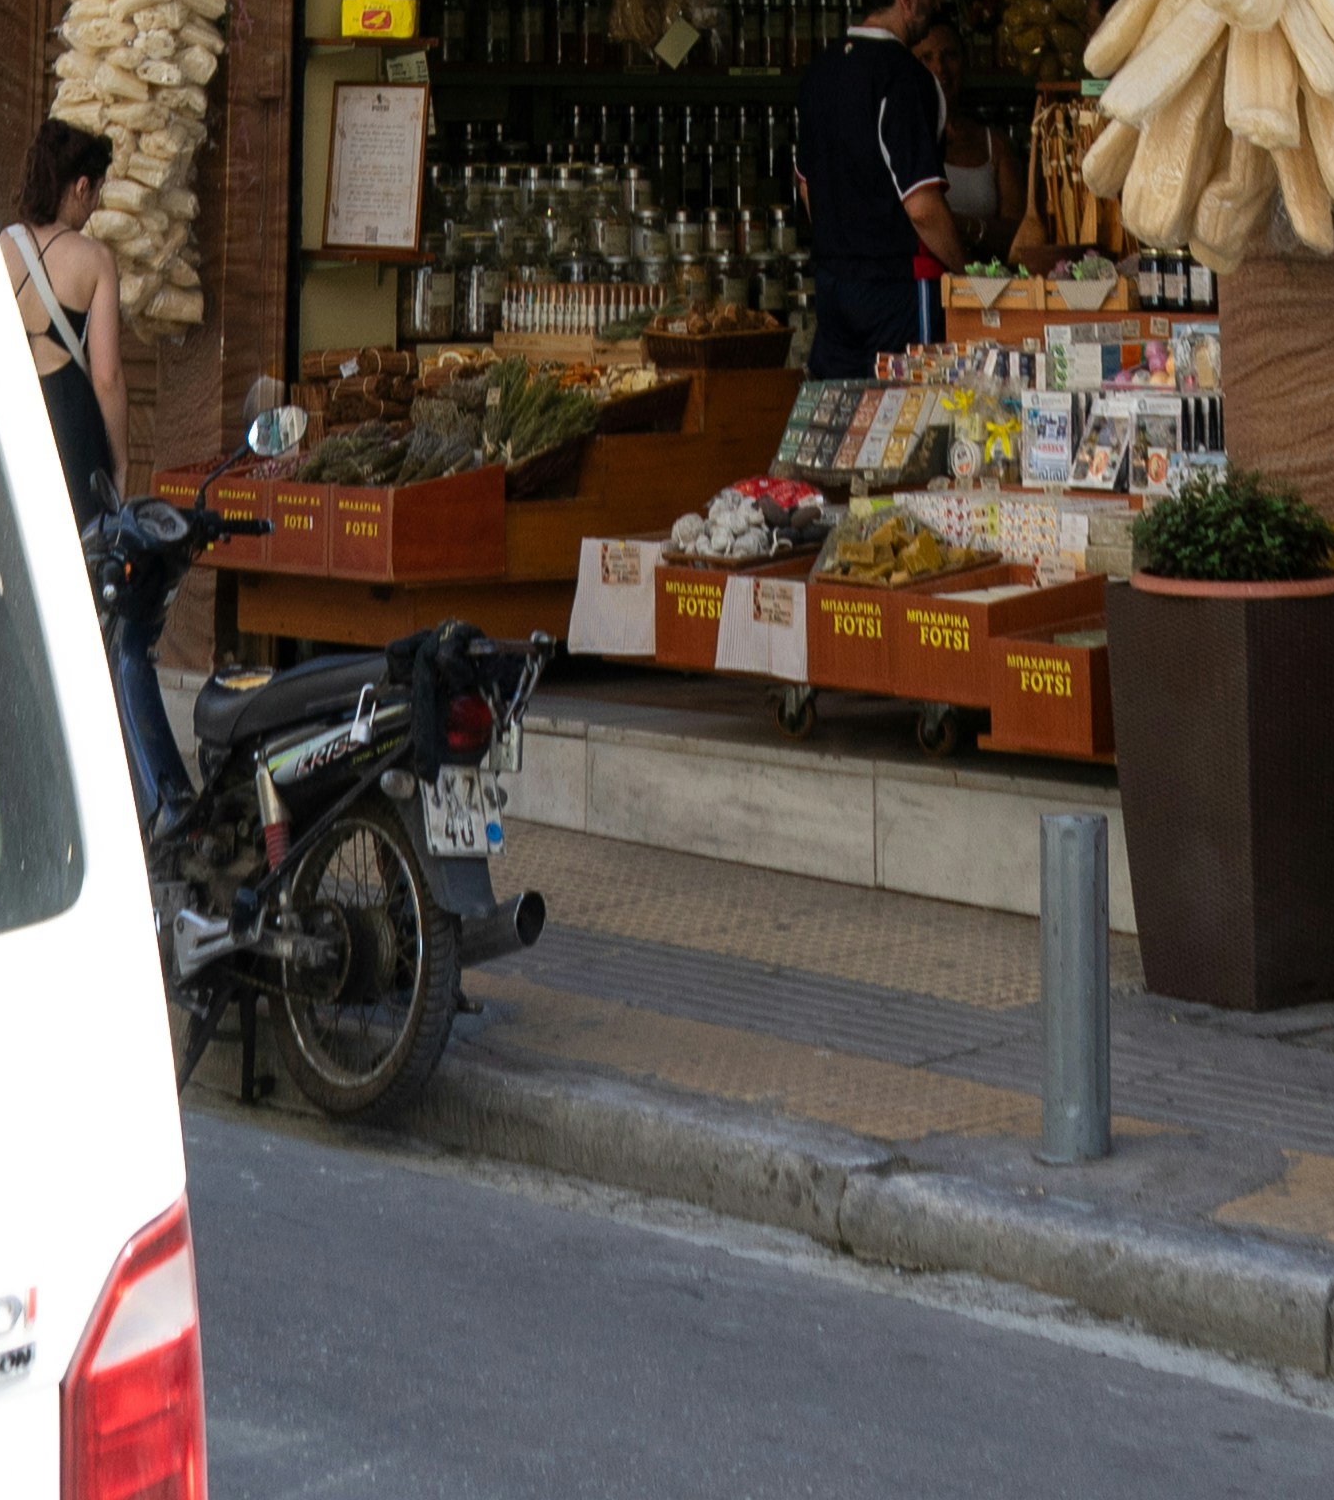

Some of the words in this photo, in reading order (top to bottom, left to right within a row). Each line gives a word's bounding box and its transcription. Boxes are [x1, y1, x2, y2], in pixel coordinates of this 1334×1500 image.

[284, 514, 313, 530] FOTSI
[346, 521, 378, 537] FOTSI
[666, 581, 722, 599] ΜΠΑΧΑΡΙΚΑ
[677, 597, 722, 619] FOTSI
[821, 599, 882, 617] ΜΠΑΧΑΡΙΚΑ
[833, 615, 883, 639] FOTSI
[907, 609, 969, 629] ΜΠΑΧΑΡΙΚΑ
[920, 626, 970, 652] FOTSI
[1006, 654, 1071, 674] ΜΠΑΧΑΡΙΚΑ
[1020, 671, 1072, 697] FOTSI
